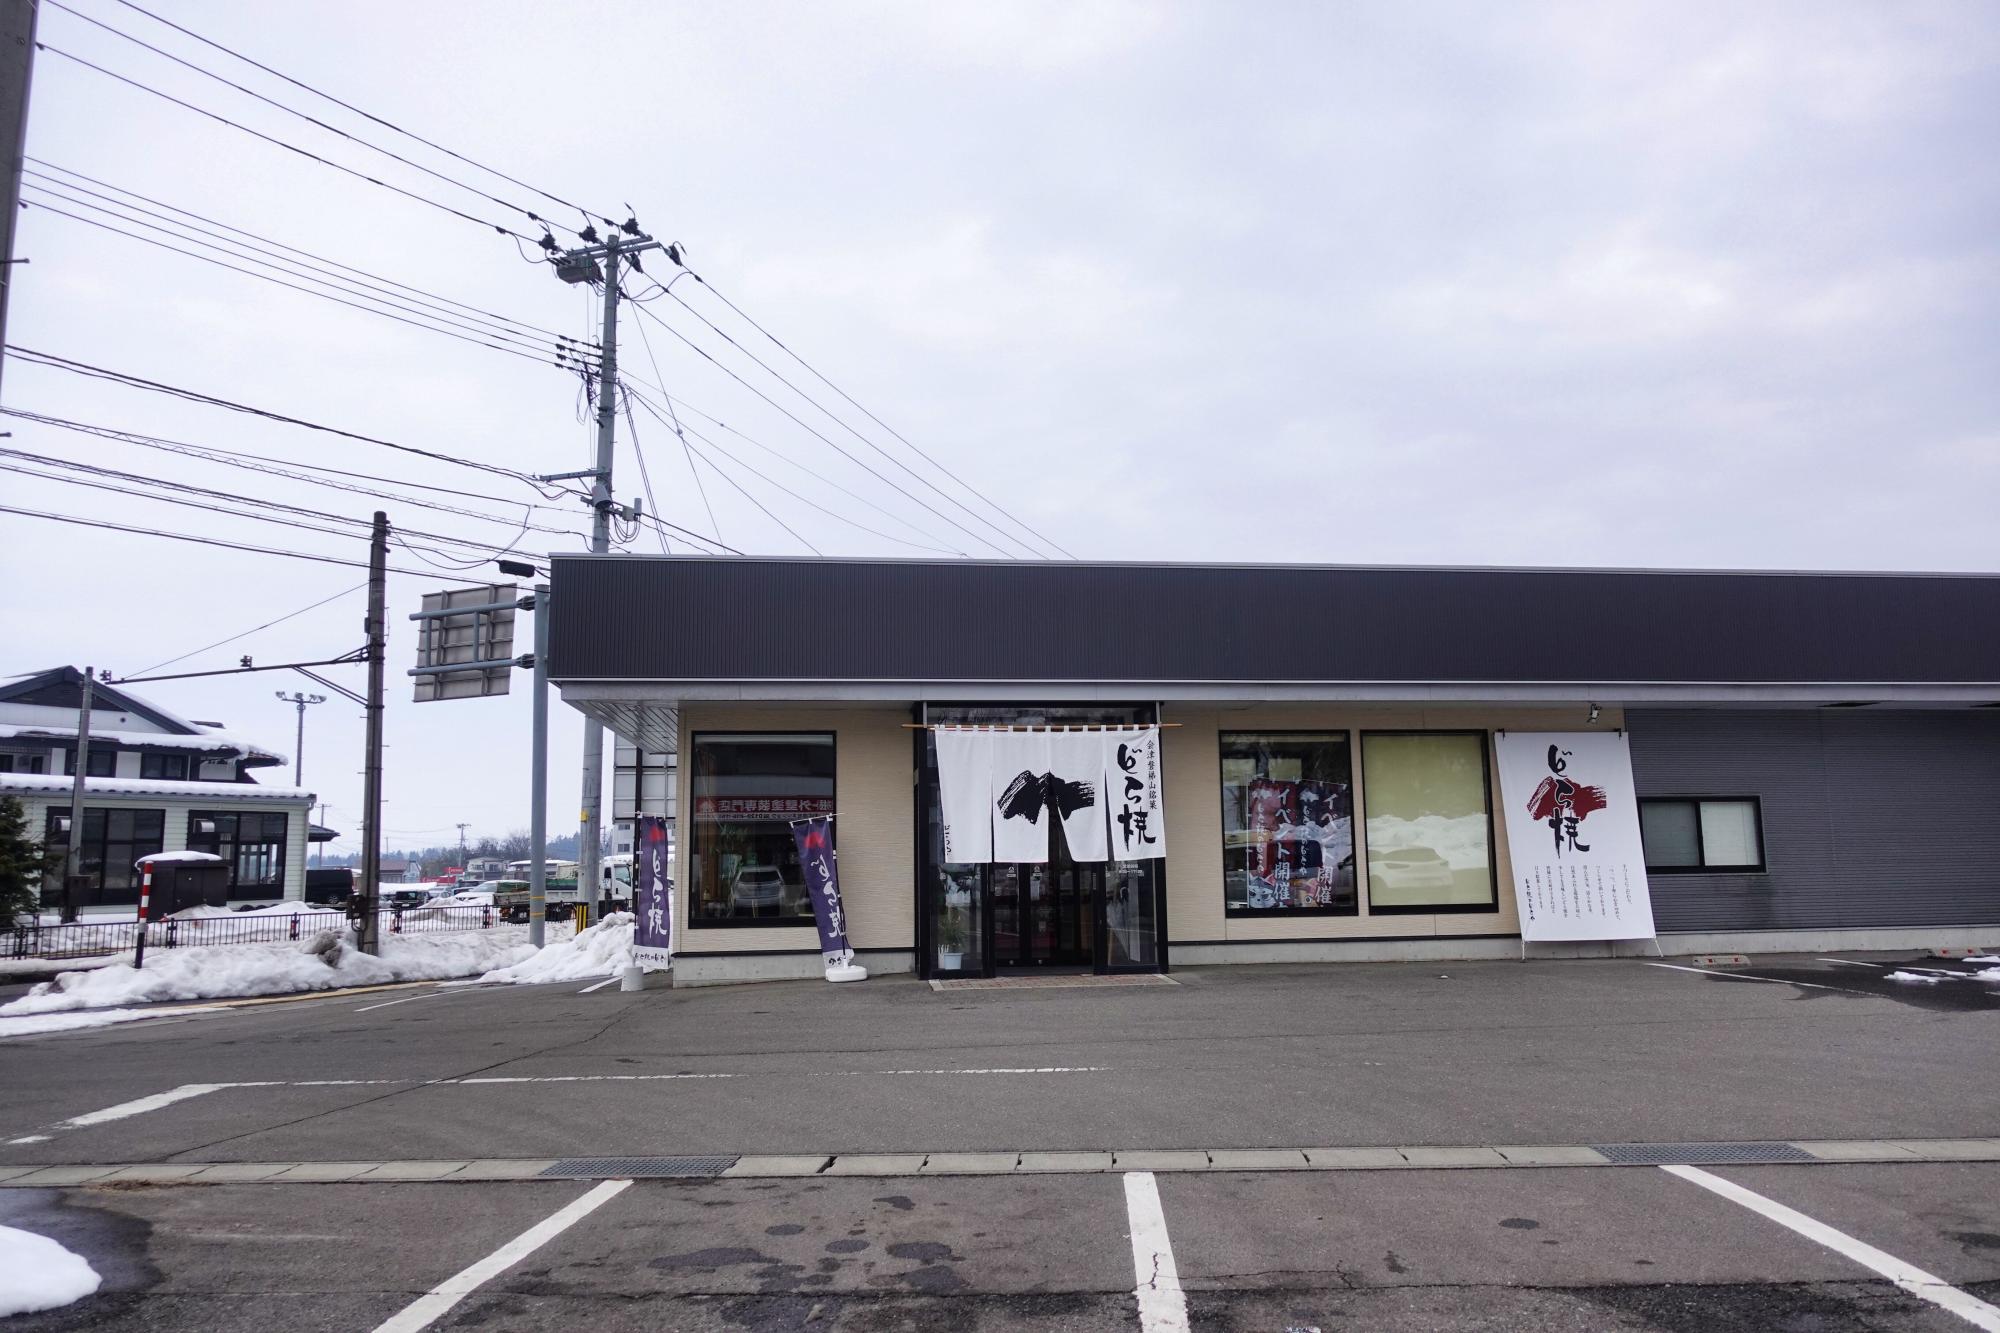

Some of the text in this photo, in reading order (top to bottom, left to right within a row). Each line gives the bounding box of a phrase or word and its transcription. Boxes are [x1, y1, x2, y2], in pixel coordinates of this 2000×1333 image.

[1117, 743, 1157, 852] どら焼
[1548, 744, 1590, 859] どら焼
[647, 848, 667, 939] どら焼
